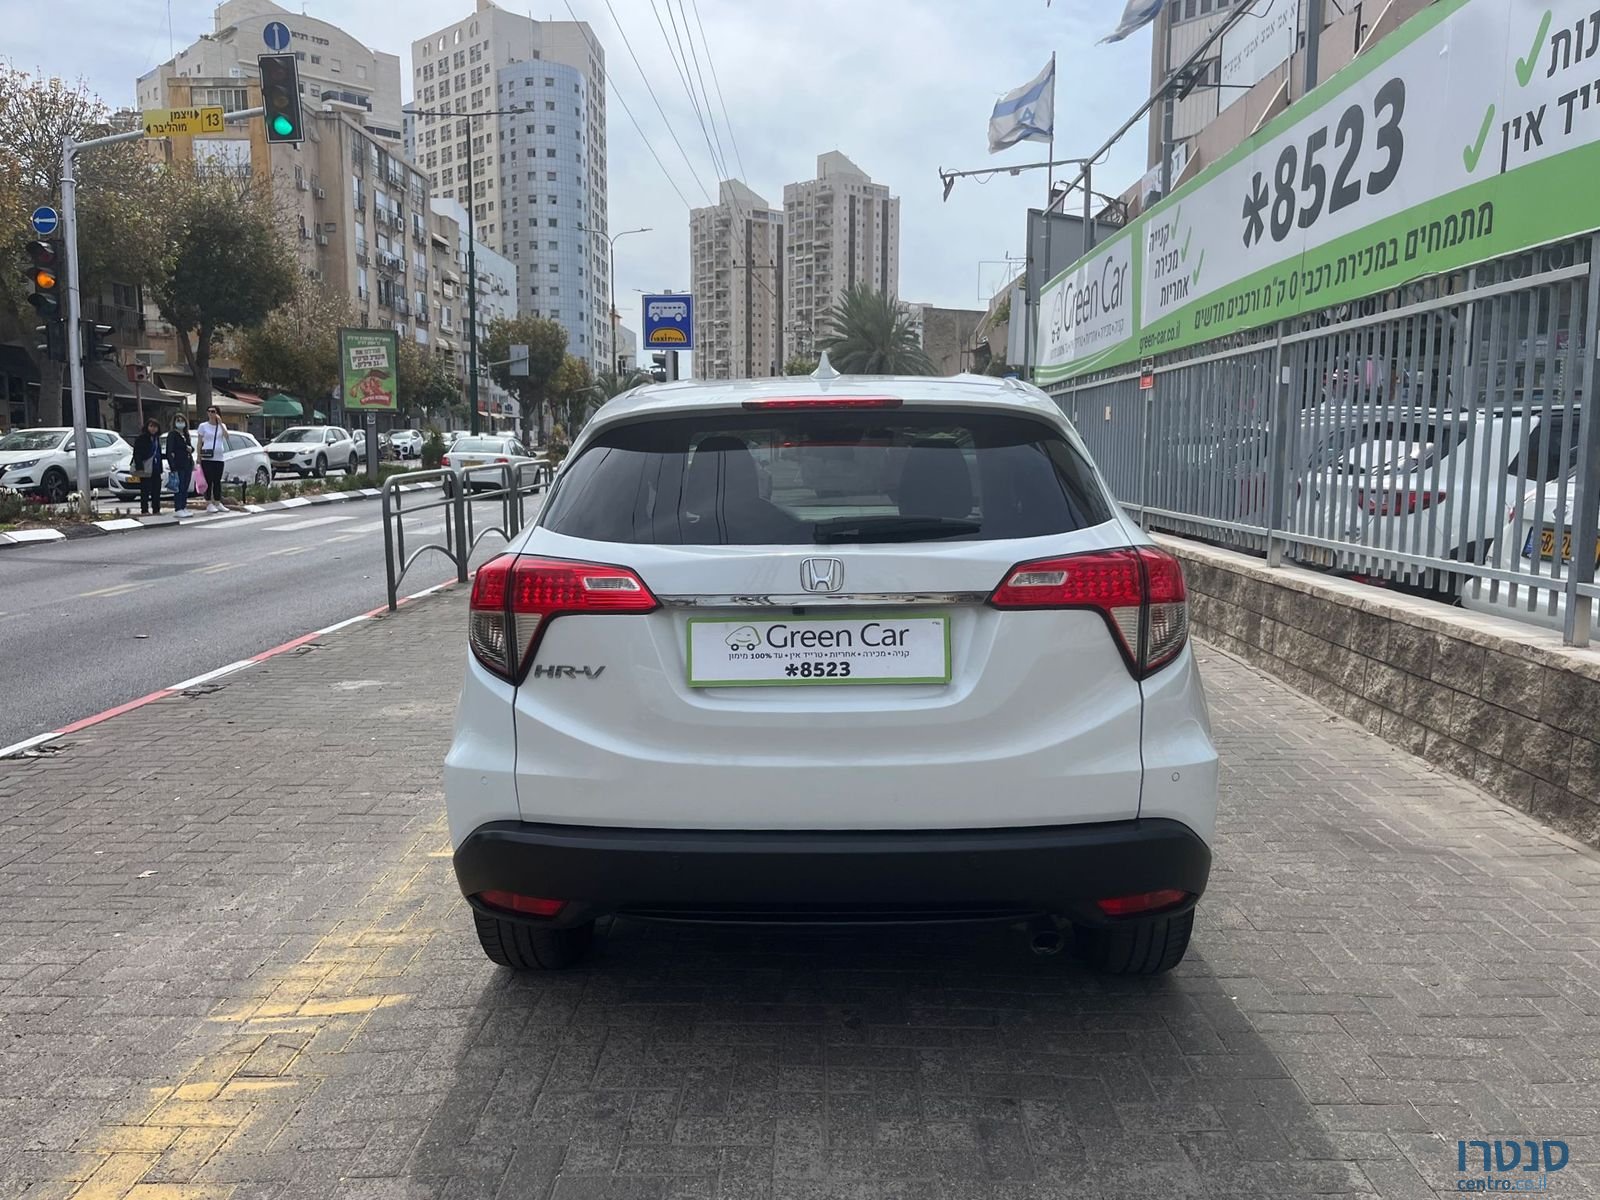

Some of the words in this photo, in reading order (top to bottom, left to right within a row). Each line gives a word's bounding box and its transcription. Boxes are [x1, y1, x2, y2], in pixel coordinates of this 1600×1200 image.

[153, 122, 187, 133] מוהליבר
[206, 113, 220, 127] 13
[1500, 104, 1547, 174] אין
[1149, 223, 1170, 253] קנייה
[1404, 201, 1494, 262] מתמחים
[1154, 249, 1179, 280] מכירה
[1334, 237, 1398, 286] במכירת
[1063, 282, 1098, 332] Green
[1101, 255, 1128, 313] Car
[1160, 275, 1190, 307] אחריות
[1302, 263, 1331, 296] רכבי
[1194, 302, 1225, 330] חדשים
[1227, 288, 1261, 319] ורכבים
[1138, 319, 1181, 354] green-car.co.il
[766, 624, 852, 648] Green
[860, 622, 910, 647] Car
[729, 653, 748, 661] מימון
[751, 652, 772, 660] 100%
[789, 652, 801, 660] אין
[862, 650, 886, 658] מכירה
[892, 650, 910, 658] קניה
[534, 664, 607, 680] HR-V
